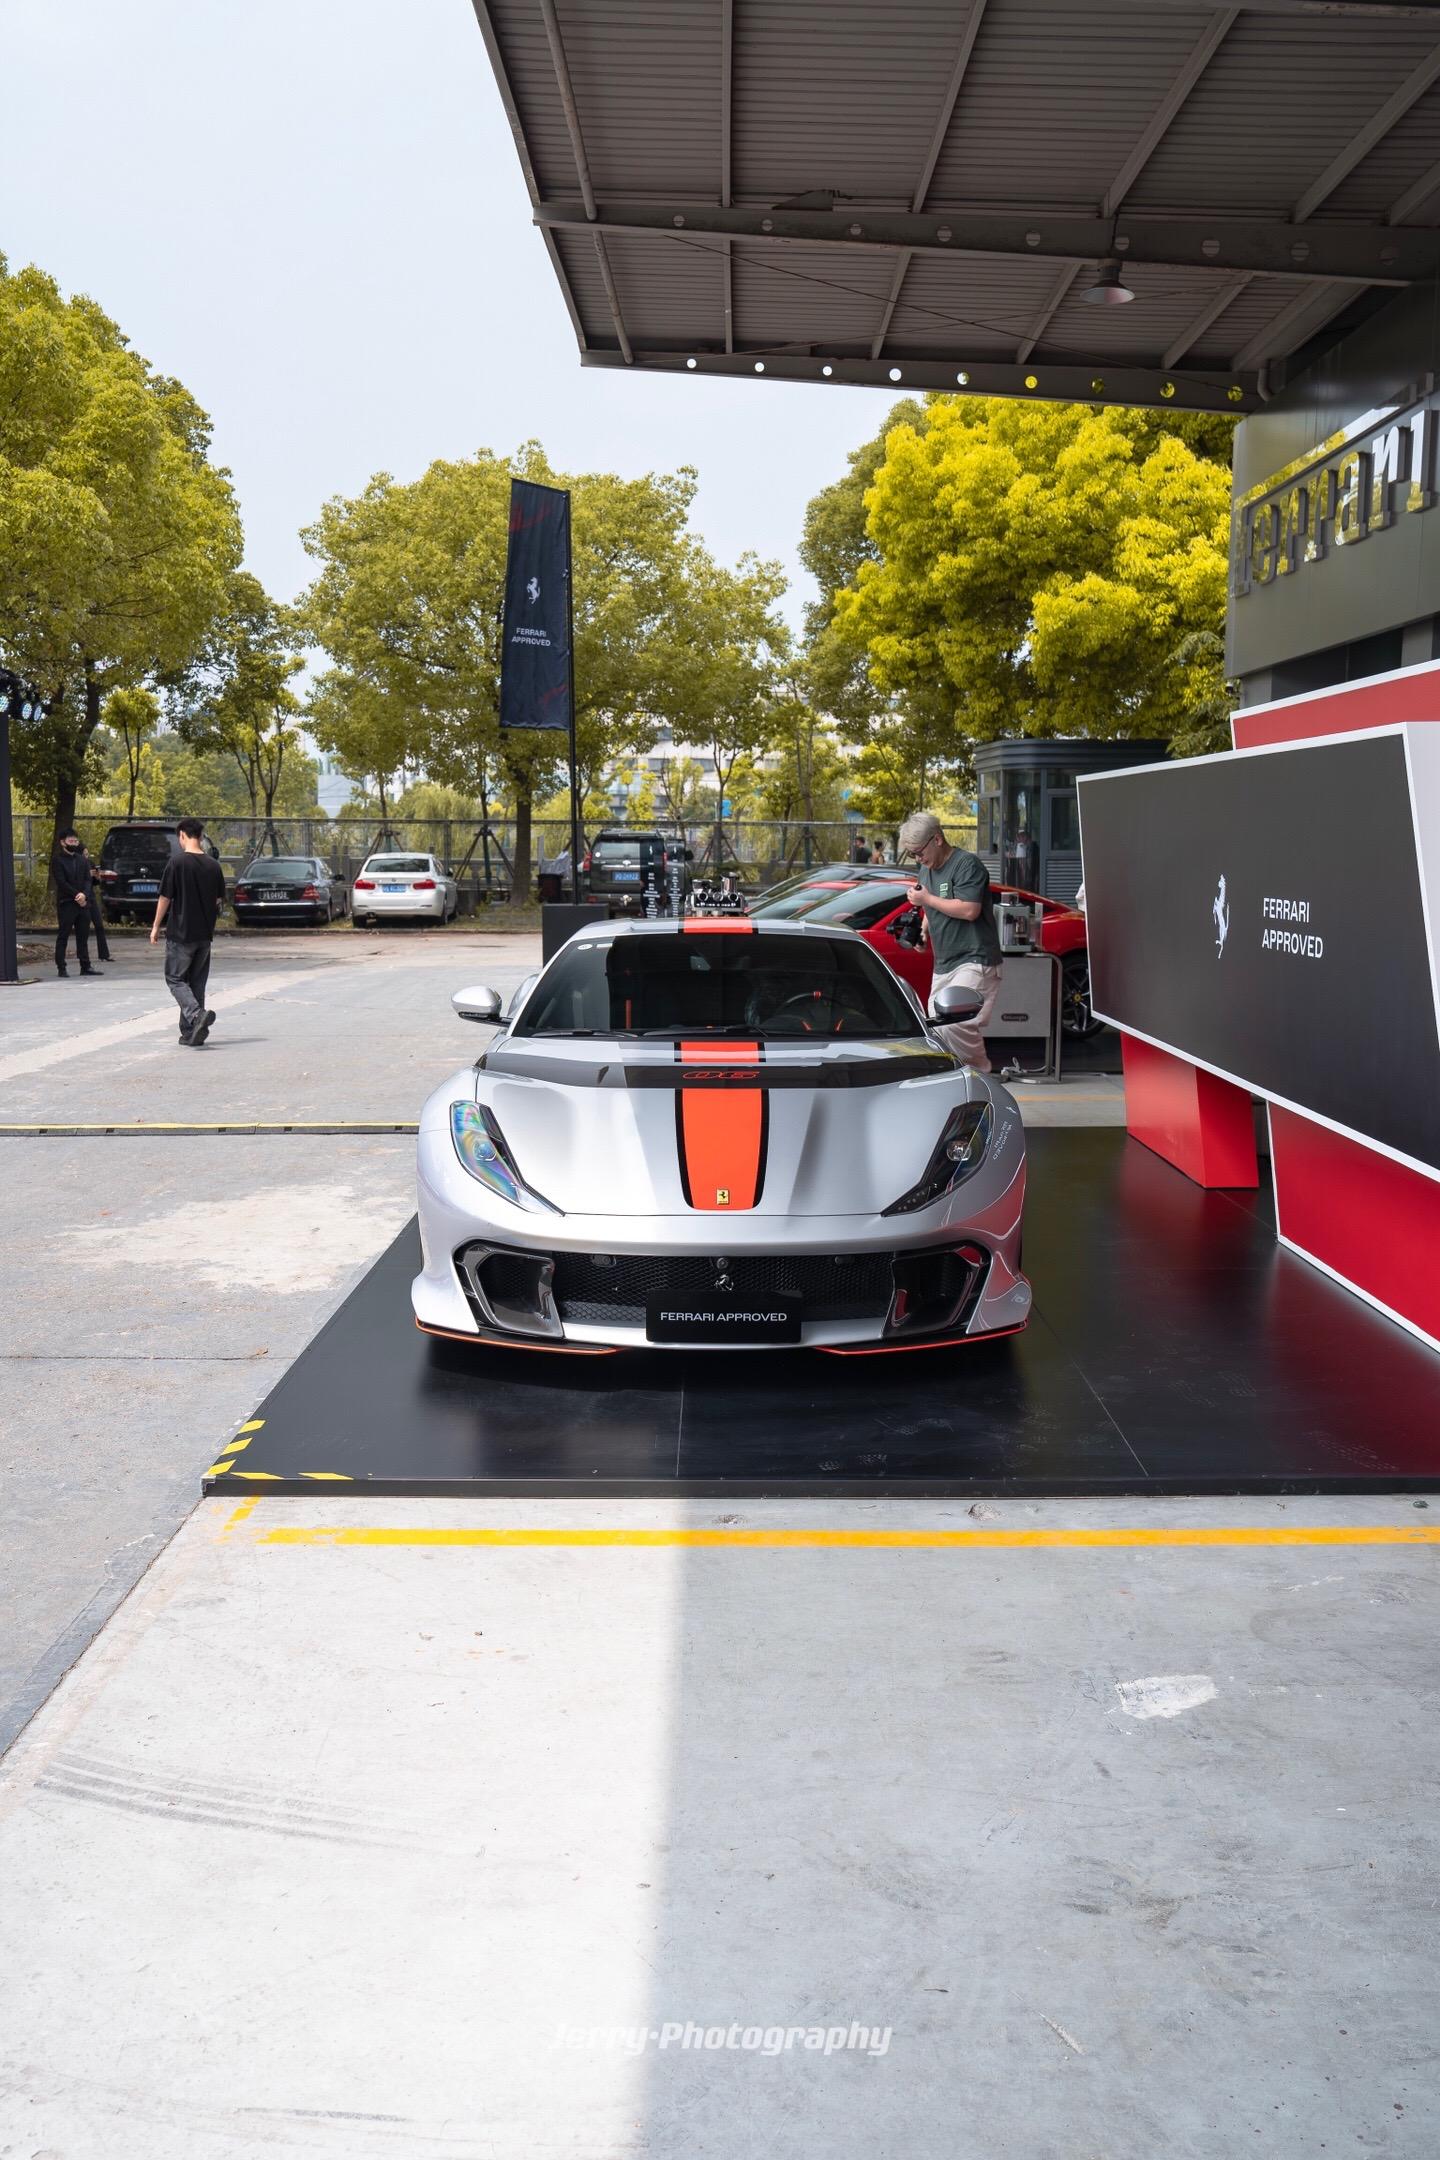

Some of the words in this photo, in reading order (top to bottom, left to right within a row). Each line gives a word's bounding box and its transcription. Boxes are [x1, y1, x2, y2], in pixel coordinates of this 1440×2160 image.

[1231, 376, 1434, 600] Ferrari
[516, 627, 547, 637] FERRARI
[511, 636, 551, 647] APPROVED
[1263, 897, 1310, 923] FERRARI
[1262, 928, 1324, 959] APPROVED
[660, 1312, 715, 1321] FERRARI
[716, 1312, 788, 1322] APPROVED
